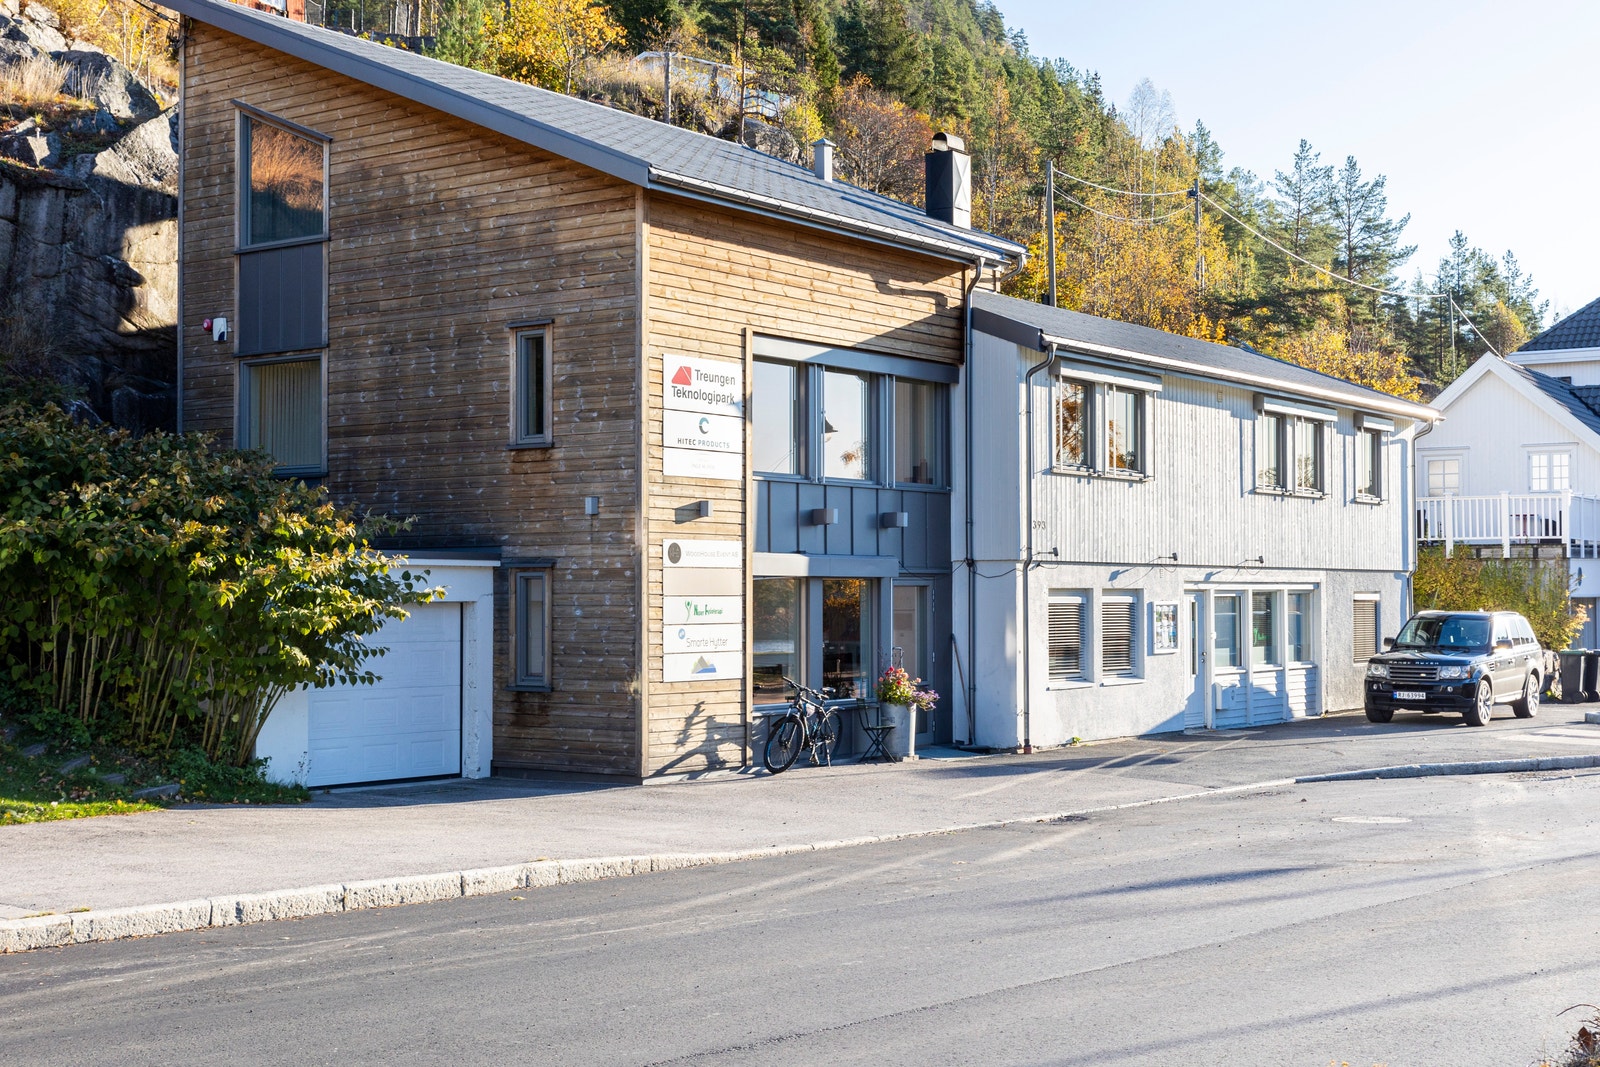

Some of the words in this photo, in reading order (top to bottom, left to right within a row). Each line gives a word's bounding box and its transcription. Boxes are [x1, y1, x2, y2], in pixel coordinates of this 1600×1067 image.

[694, 369, 736, 387] Treungen
[671, 385, 735, 405] Teknologipark
[677, 437, 697, 446] HITEC
[697, 439, 730, 449] PRODUCTS
[1032, 520, 1046, 530] 393
[686, 637, 709, 648] Smarte
[709, 637, 728, 650] Hytter
